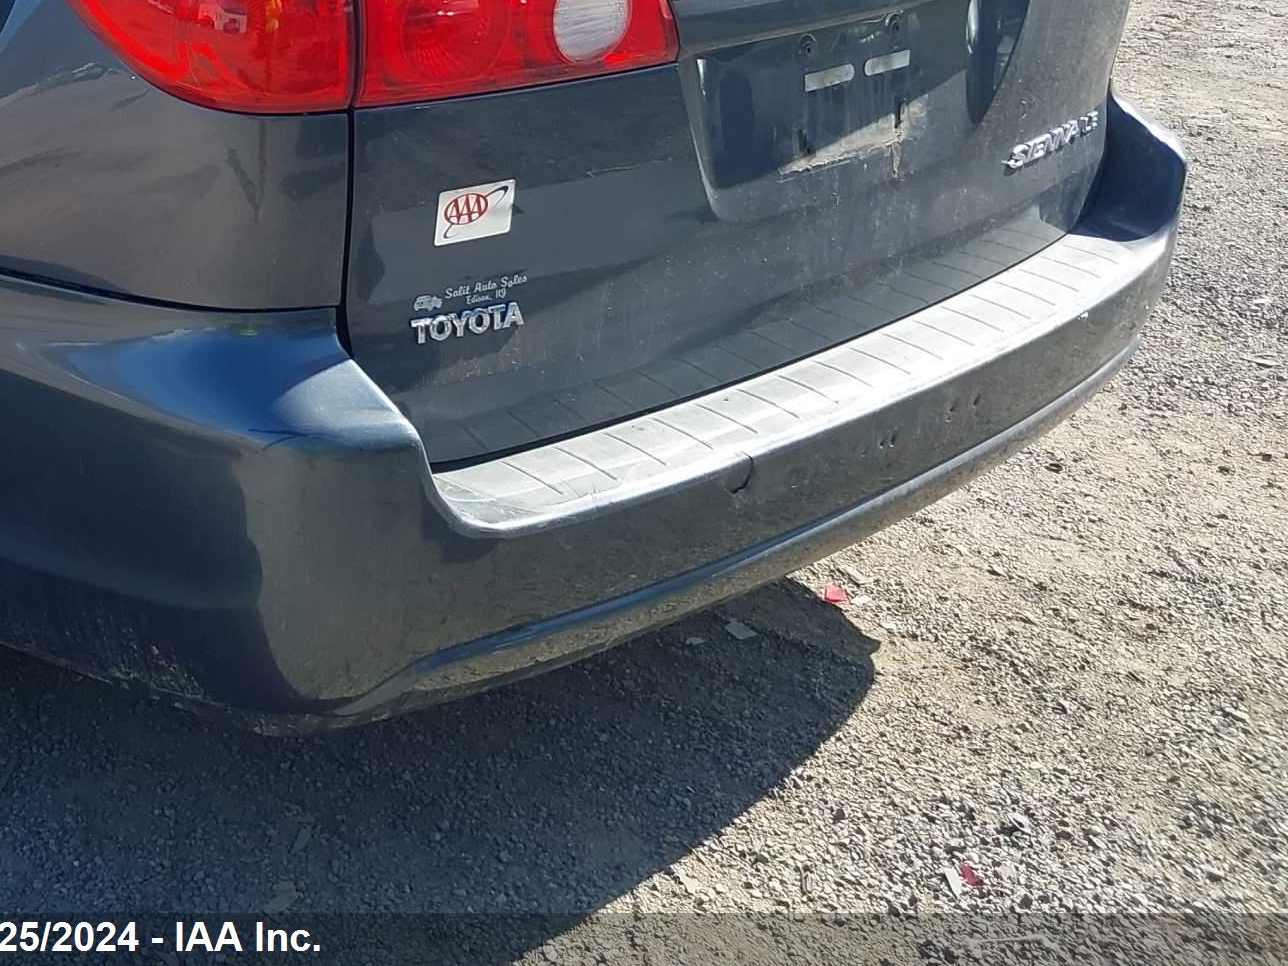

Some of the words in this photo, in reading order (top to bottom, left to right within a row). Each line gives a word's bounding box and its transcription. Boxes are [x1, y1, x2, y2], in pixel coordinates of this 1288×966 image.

[1002, 120, 1078, 168] SIENNA
[446, 194, 486, 224] AAA
[474, 280, 498, 293] Auto
[500, 274, 528, 288] Sales
[411, 302, 524, 344] TOYOTA
